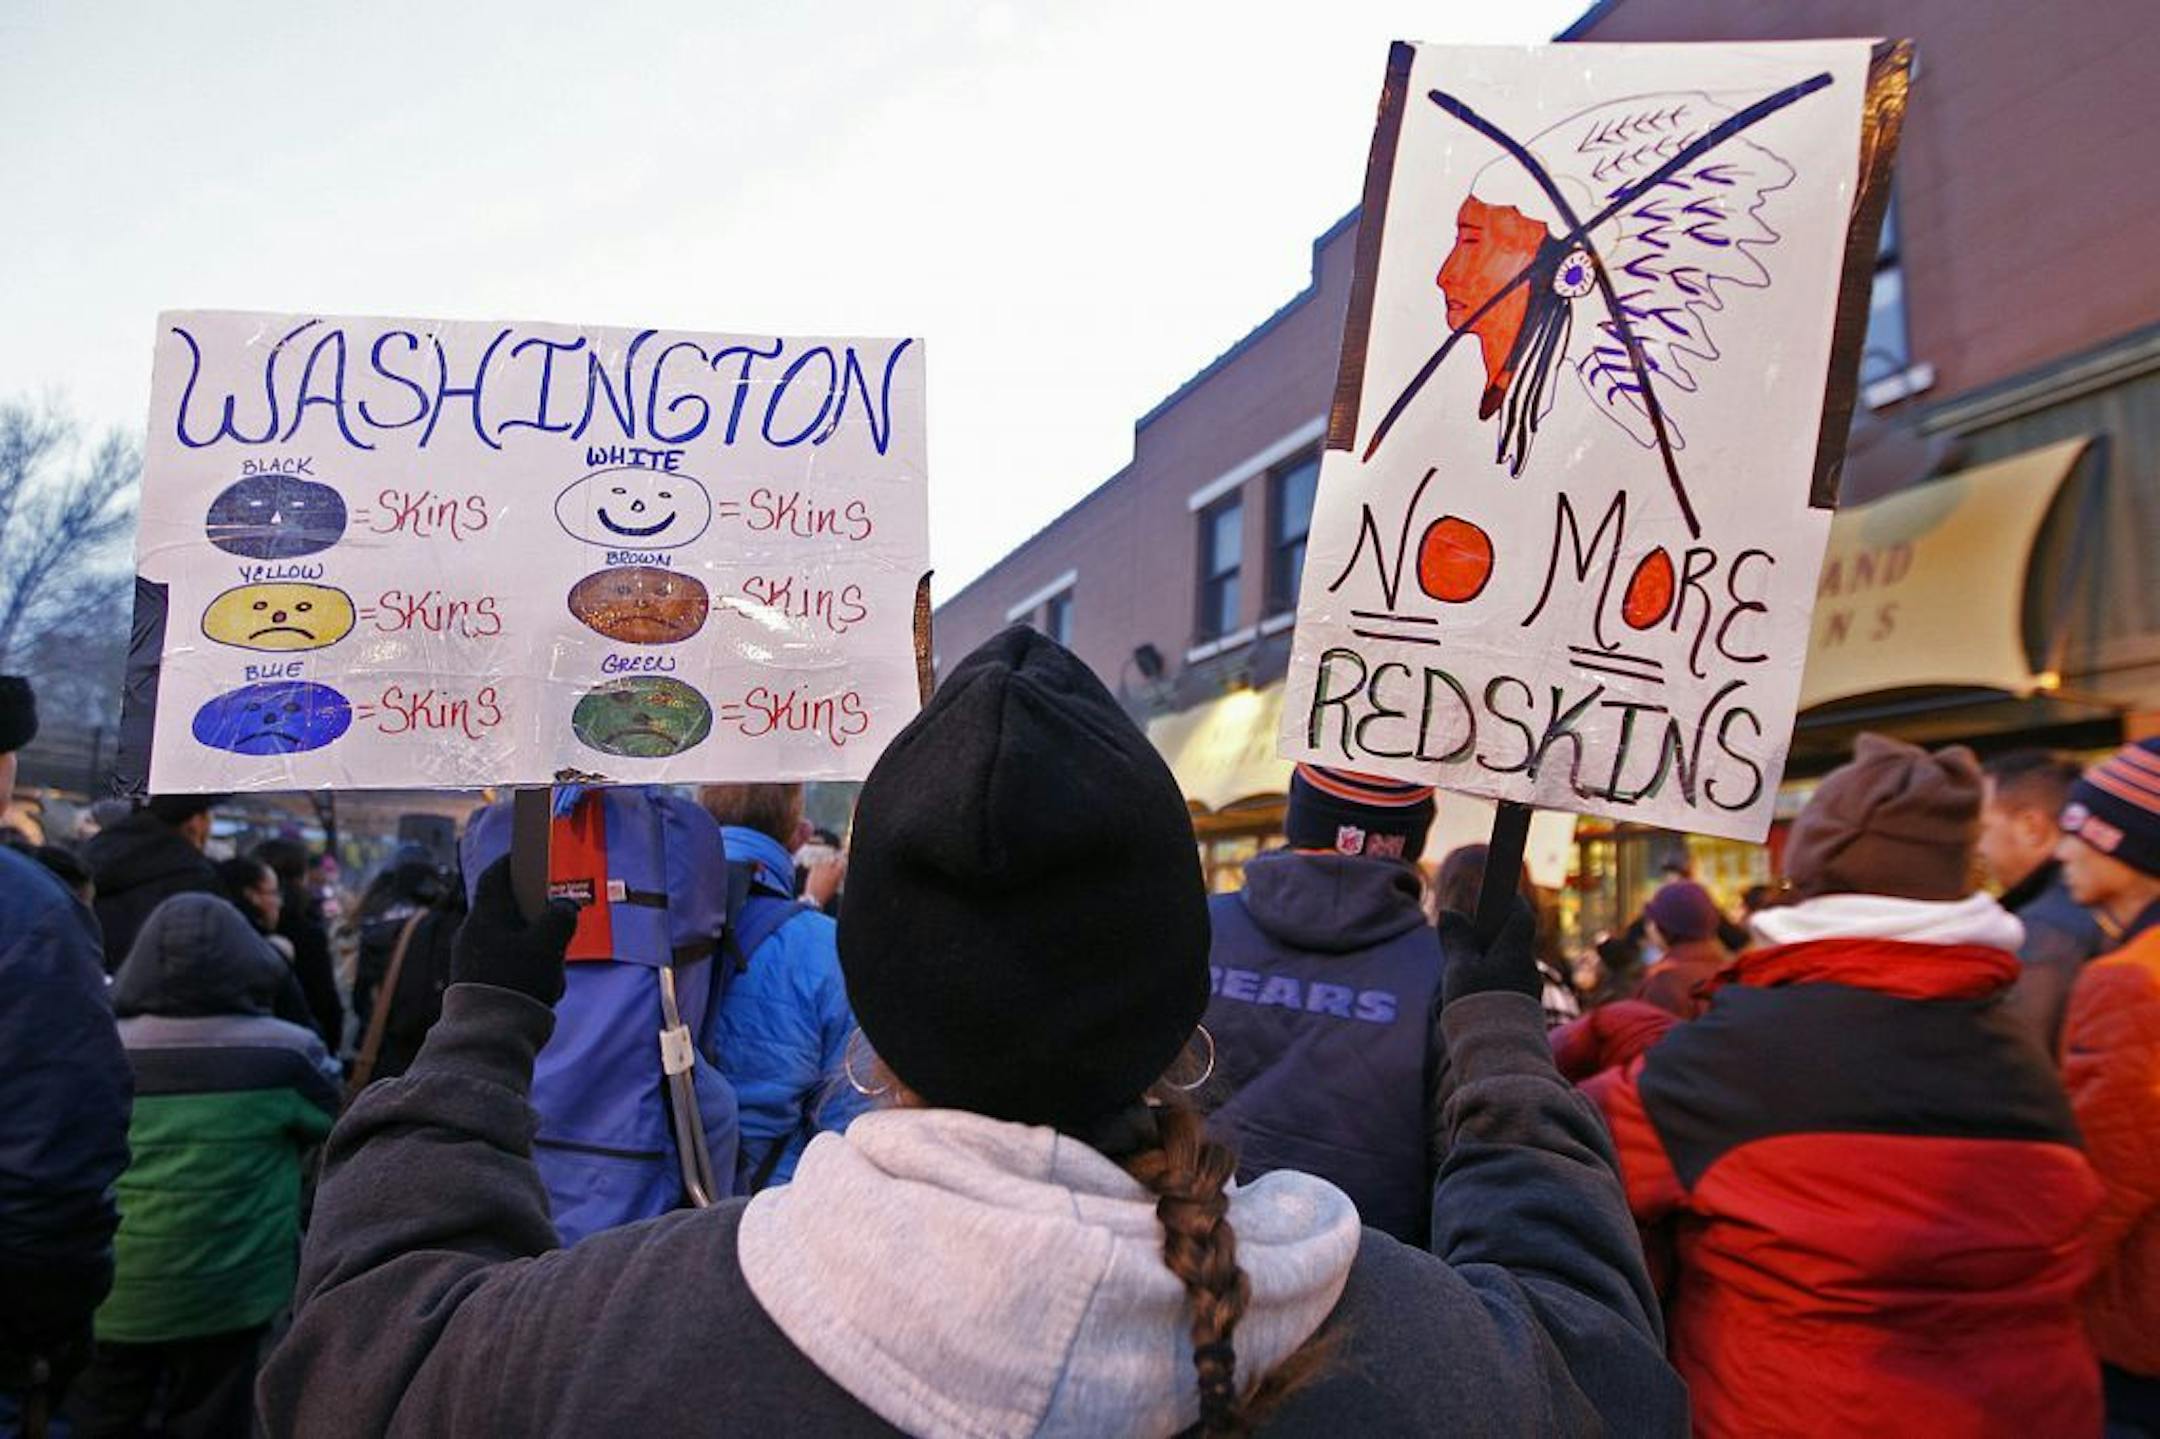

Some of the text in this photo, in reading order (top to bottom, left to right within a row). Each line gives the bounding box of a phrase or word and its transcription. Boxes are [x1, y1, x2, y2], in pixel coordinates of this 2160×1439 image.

[171, 318, 913, 456] WASHINGTON
[242, 457, 315, 475] BLACK
[586, 447, 684, 471] WHITE
[606, 551, 672, 567] BROWN
[238, 563, 325, 583] YELLOW
[1328, 467, 1775, 678] NO MORE
[244, 662, 304, 681] BLUE
[600, 653, 676, 672] GREEN
[1308, 647, 1762, 810] REDSKINS
